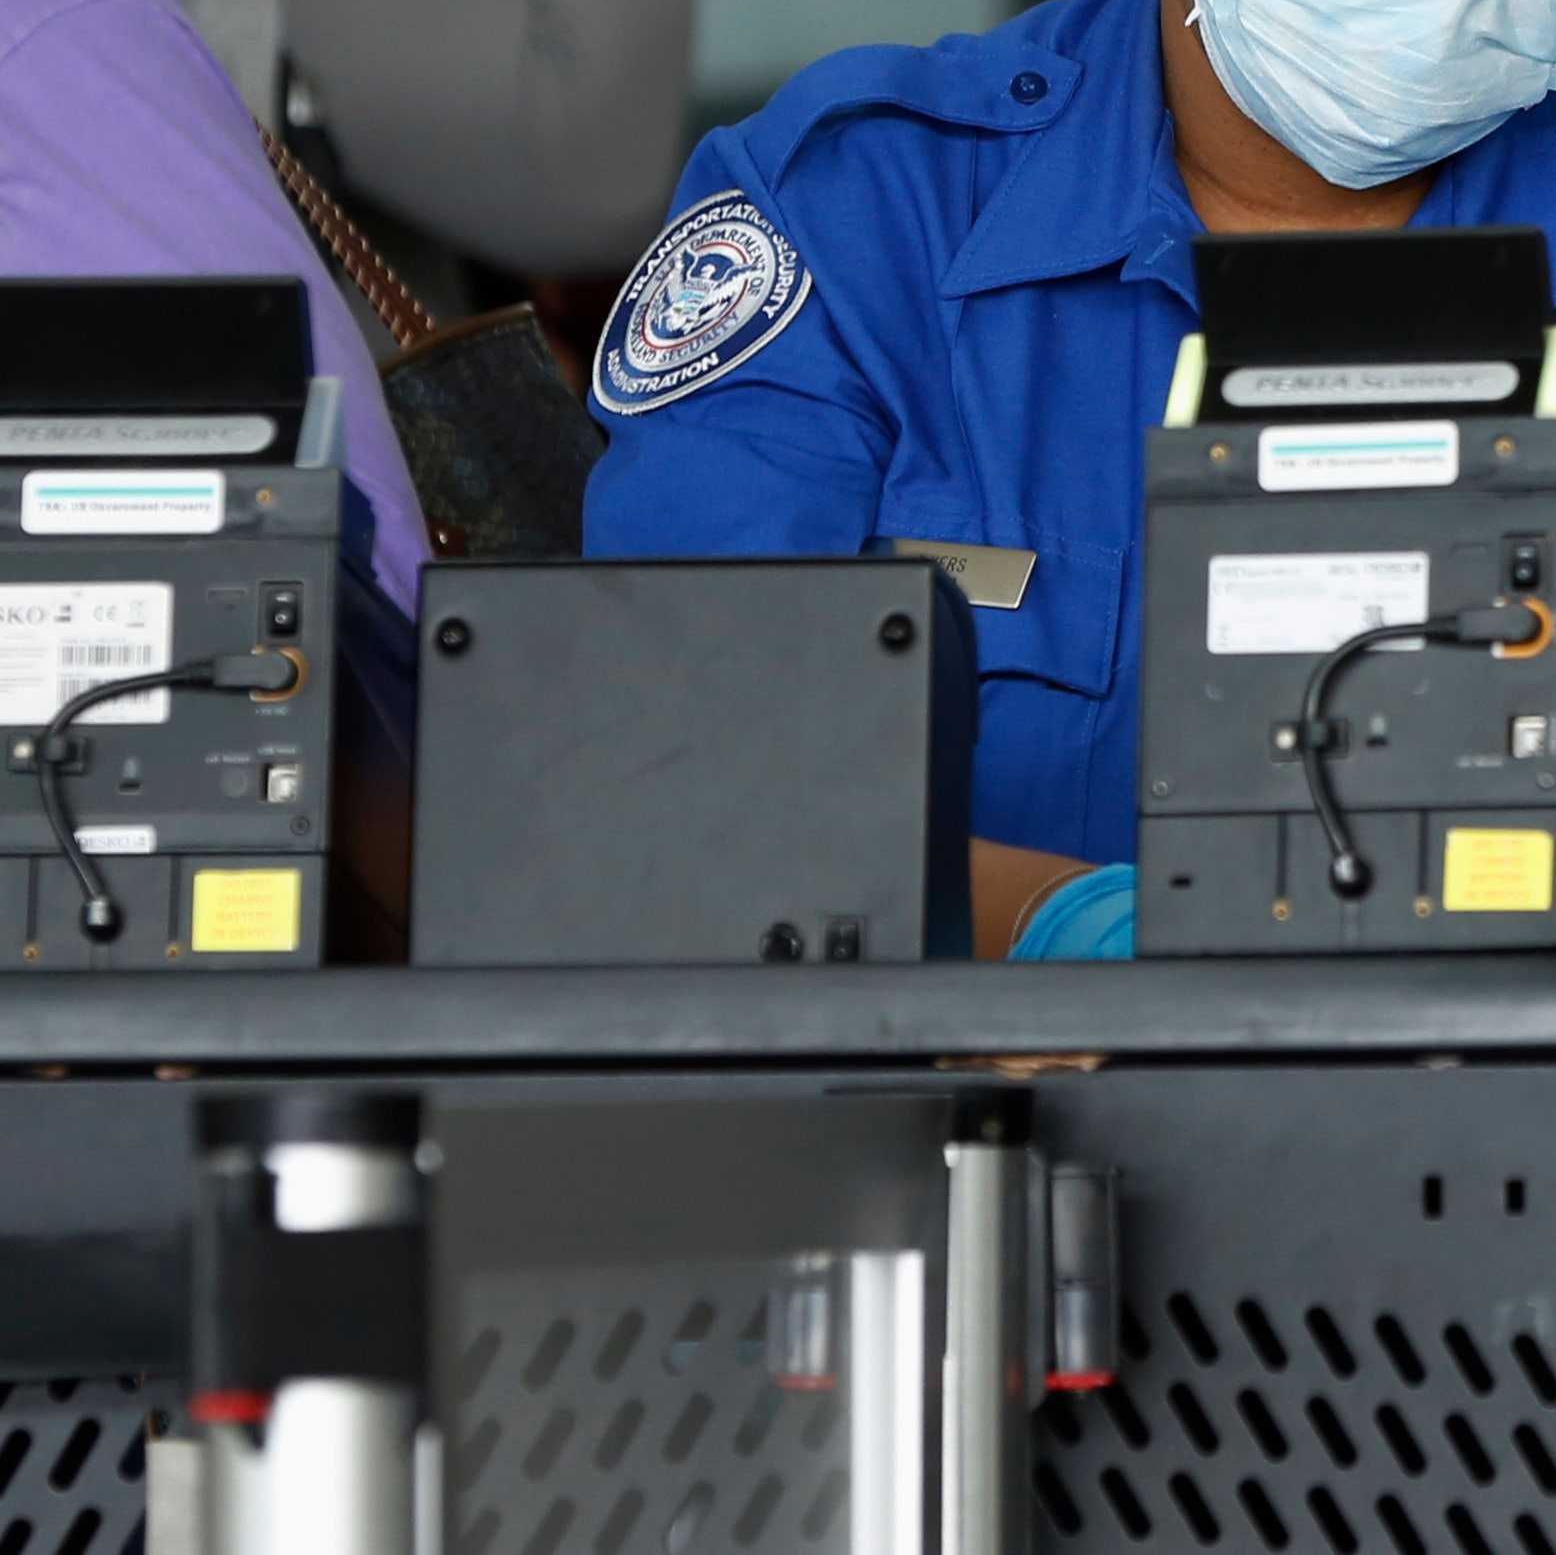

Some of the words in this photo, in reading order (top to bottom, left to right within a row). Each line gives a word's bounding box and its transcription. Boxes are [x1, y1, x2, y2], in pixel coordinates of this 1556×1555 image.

[625, 204, 775, 303] TRANSPORTATION
[762, 234, 797, 320] SECURITY
[659, 311, 738, 363] SECURITY
[607, 348, 720, 394] ADMINISTRATION
